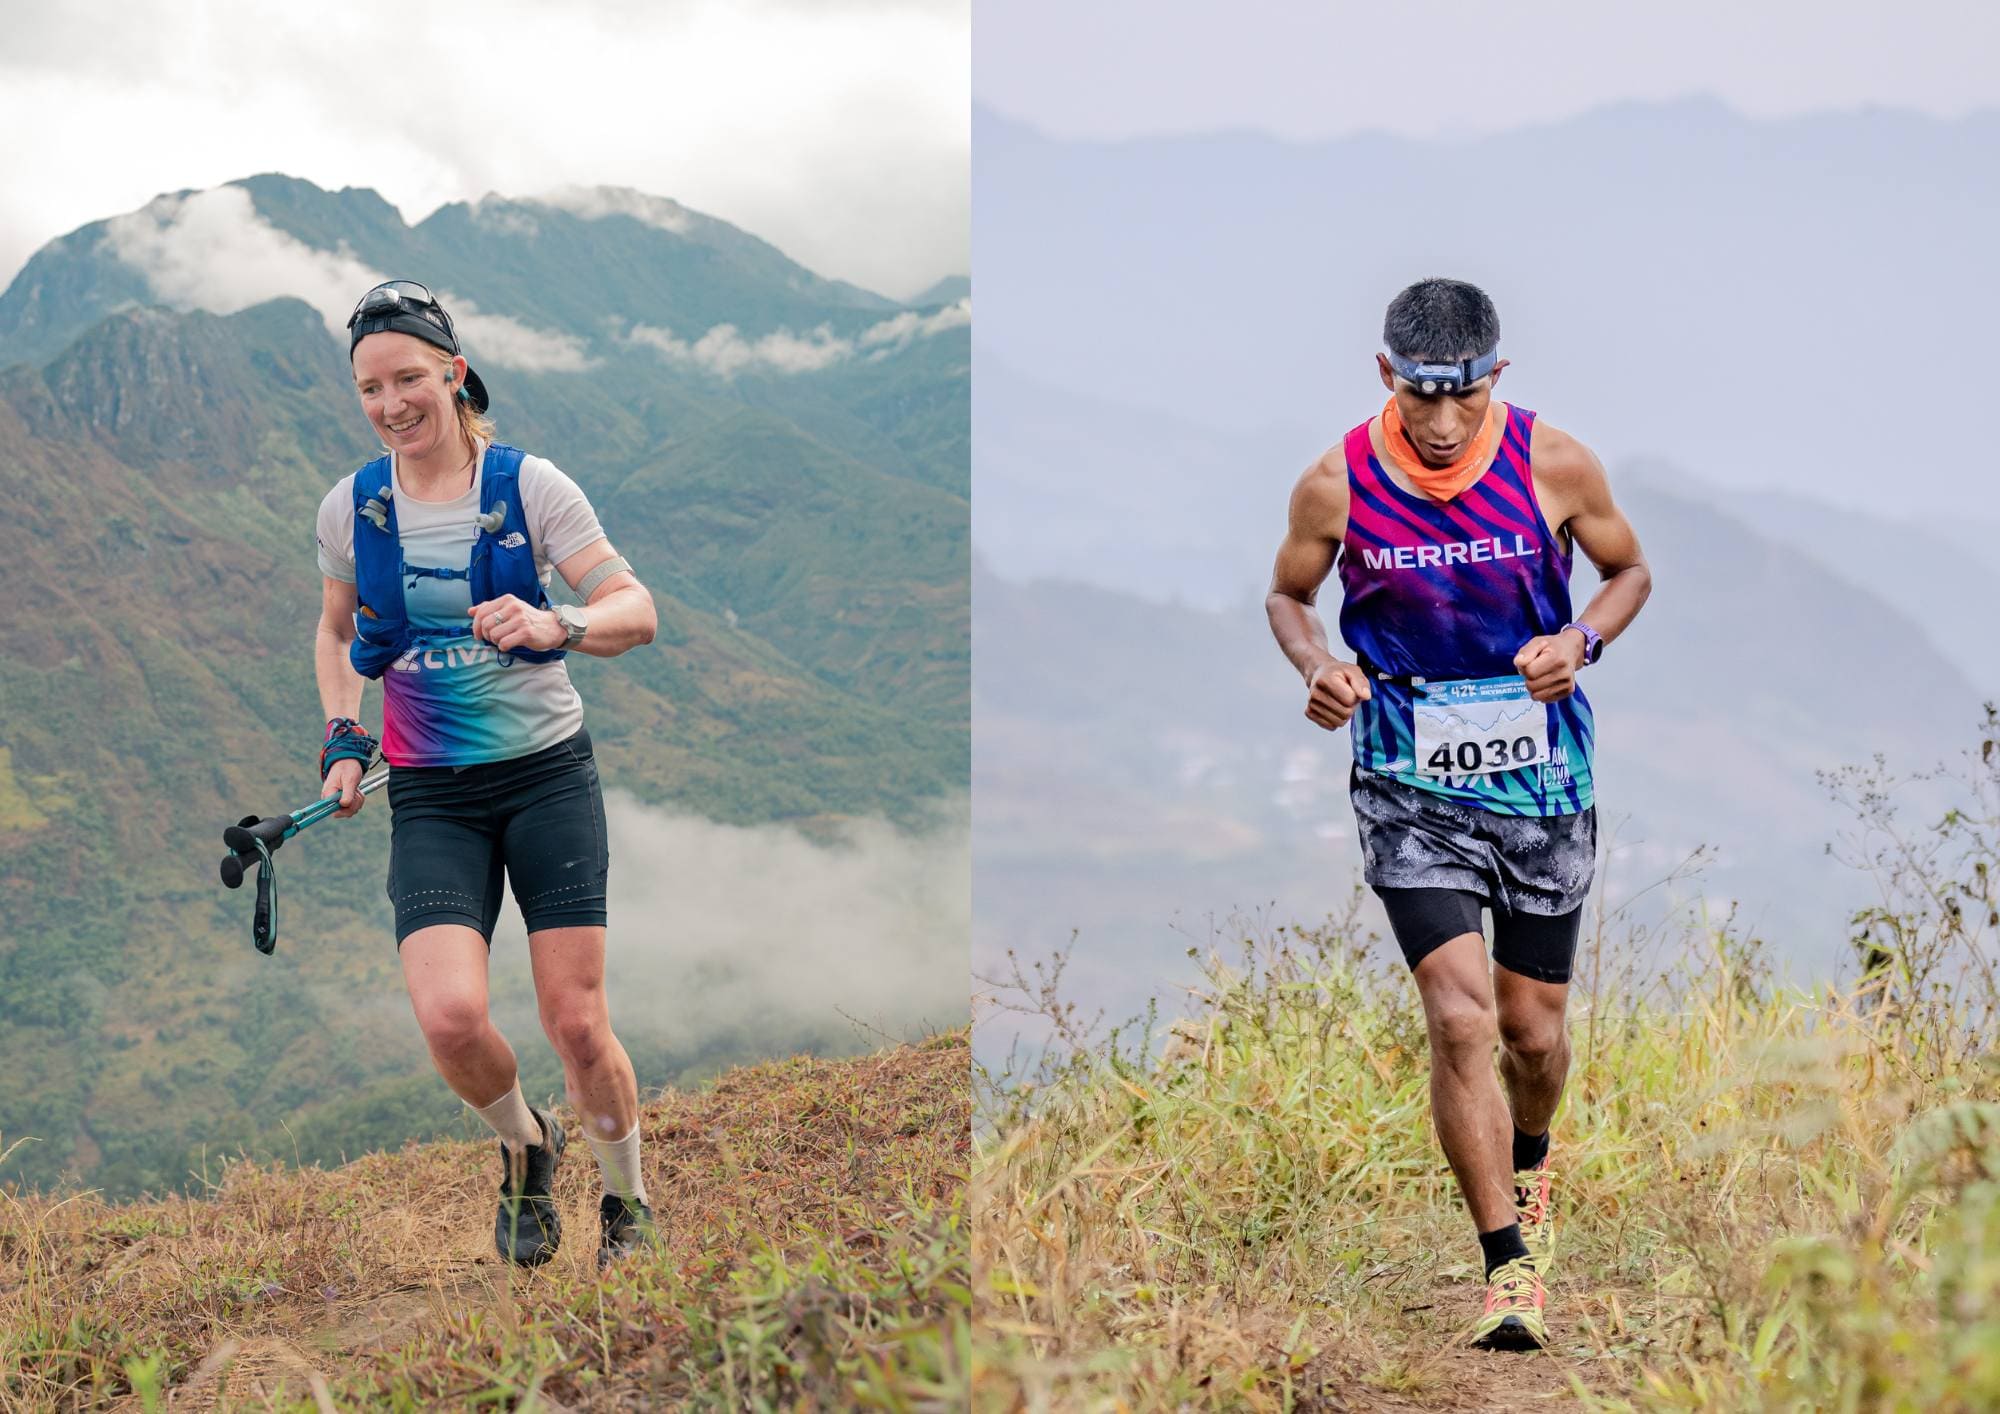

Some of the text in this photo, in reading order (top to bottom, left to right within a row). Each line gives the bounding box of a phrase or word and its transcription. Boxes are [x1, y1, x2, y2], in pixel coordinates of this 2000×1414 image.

[1362, 535, 1536, 570] MERRELL
[1451, 684, 1477, 698] 42K
[1480, 686, 1529, 696] SKYMARATH
[1428, 736, 1537, 772] 4030
